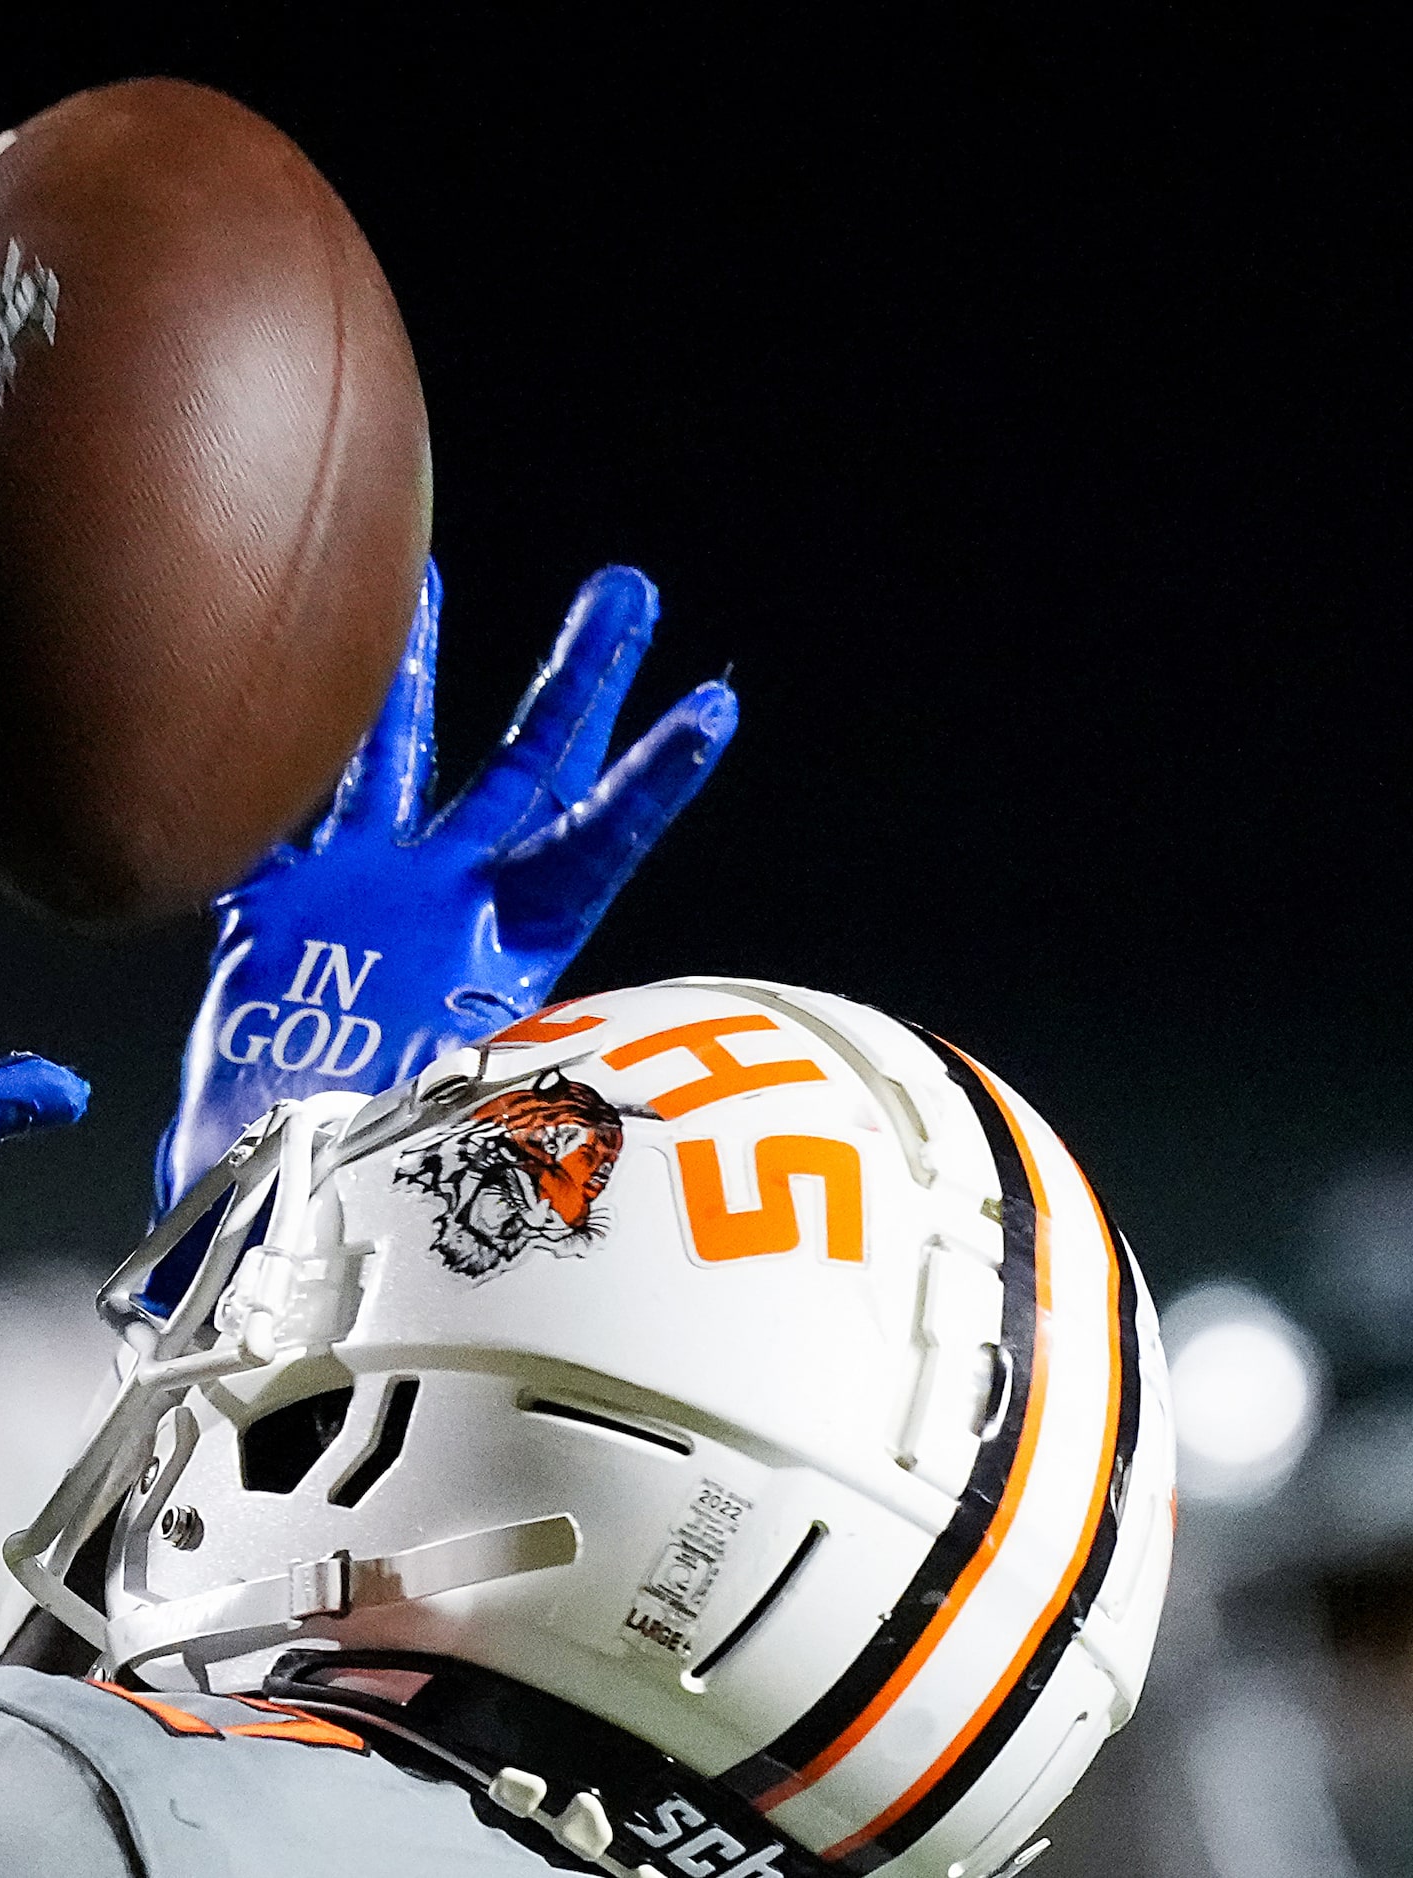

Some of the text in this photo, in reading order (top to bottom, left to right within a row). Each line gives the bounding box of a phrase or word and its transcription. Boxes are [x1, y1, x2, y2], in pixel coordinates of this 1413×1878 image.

[281, 939, 383, 1011] IN
[218, 1000, 382, 1078] GOD
[698, 1489, 743, 1521] 2022
